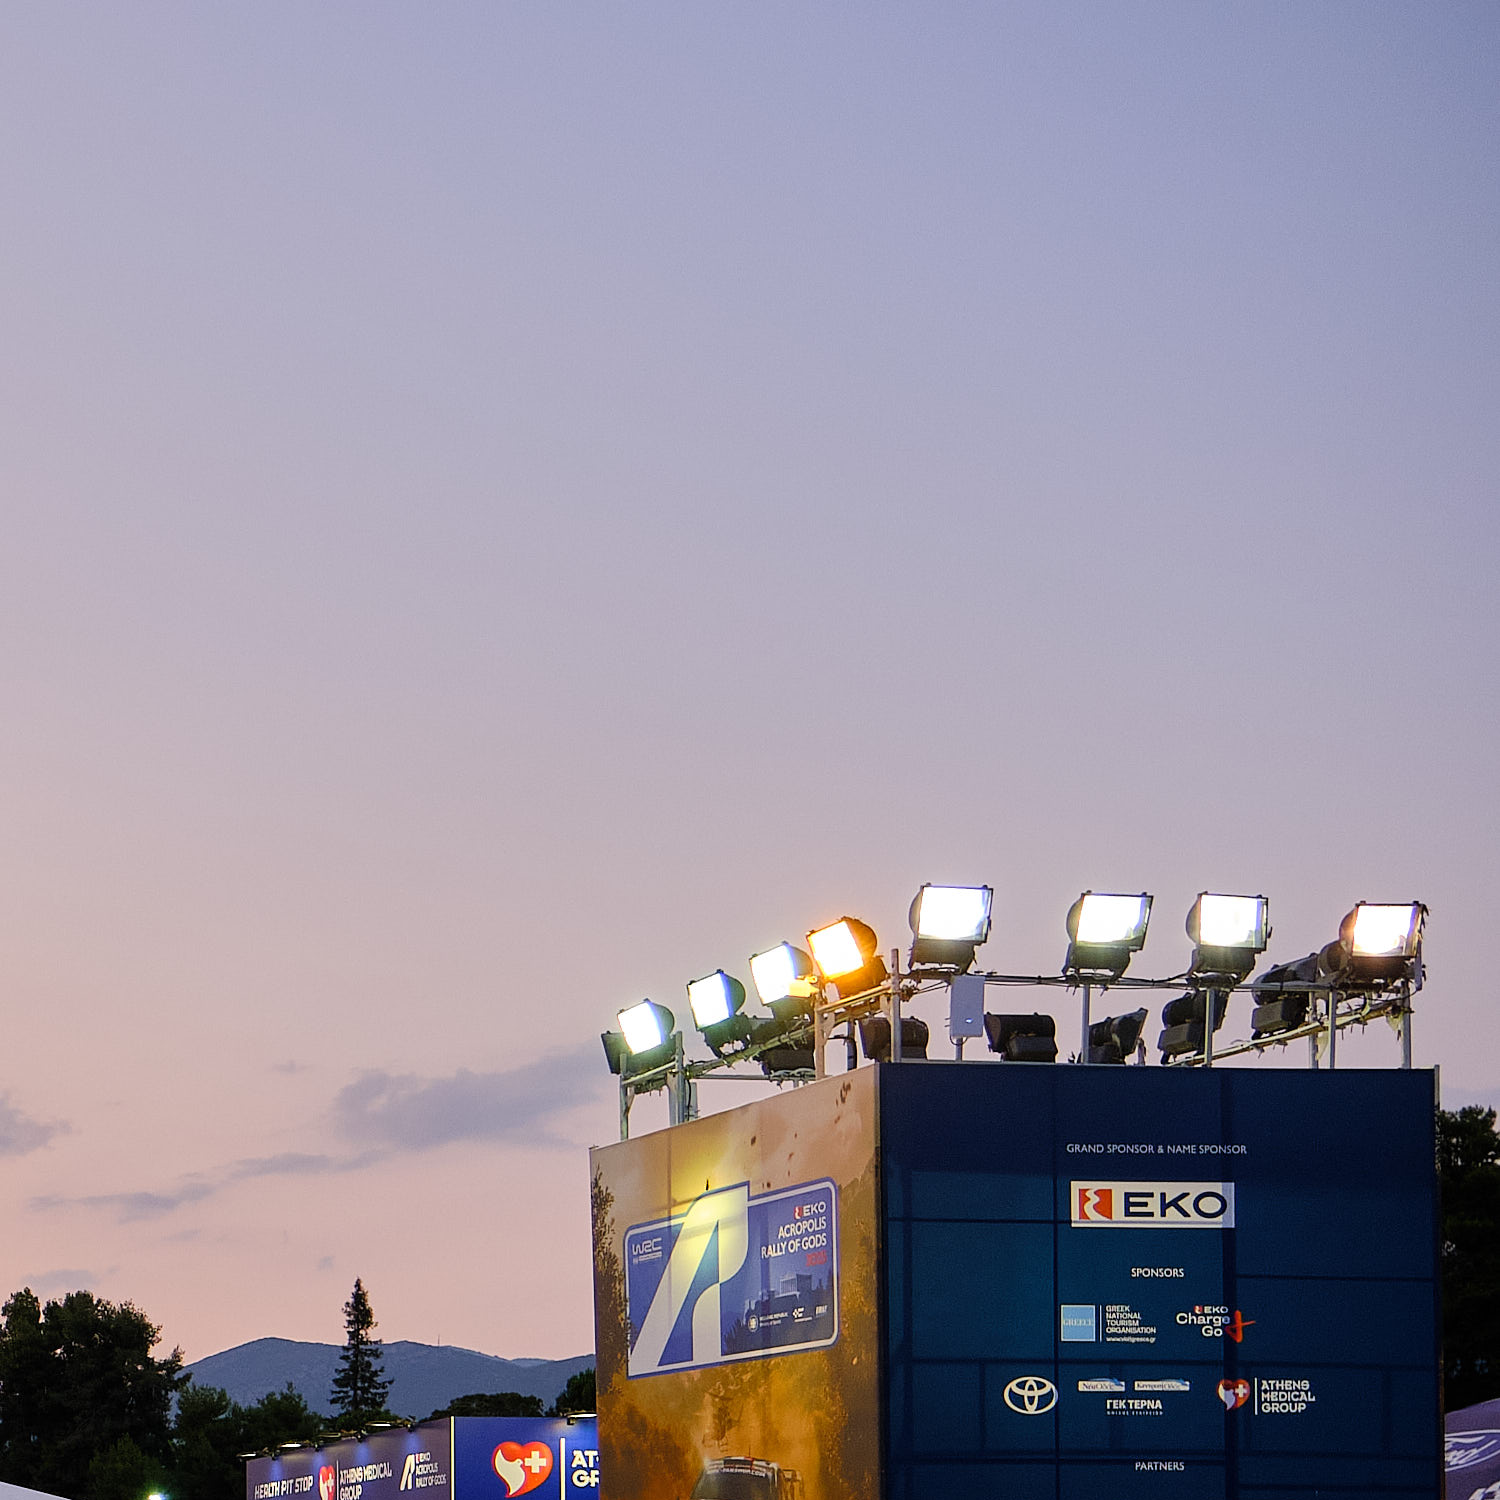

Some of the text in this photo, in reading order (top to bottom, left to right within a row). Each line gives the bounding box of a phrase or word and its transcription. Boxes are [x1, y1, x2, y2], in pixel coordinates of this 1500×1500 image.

[1066, 1143, 1247, 1155] GRAND SPONSOR & NAME SPONSOR
[803, 1201, 826, 1218] EKO
[1123, 1191, 1228, 1219] EKO
[778, 1216, 827, 1240] ACROPOLIS
[761, 1231, 827, 1260] RALLY OF GODS
[1131, 1267, 1185, 1278] SPONSORS
[1105, 1305, 1131, 1313] GREEK
[1203, 1305, 1229, 1314] EKO
[1105, 1312, 1142, 1320] NATIONAL
[1175, 1312, 1231, 1326] Charge
[1105, 1319, 1140, 1327] TOURISM
[1201, 1326, 1223, 1338] Go
[1261, 1379, 1309, 1390] ATHENS
[1261, 1391, 1316, 1402] MEDICAL
[1261, 1402, 1307, 1413] GROUP
[1134, 1461, 1185, 1471] PARTNERS
[339, 1461, 392, 1483] ATHENS MEDICAL
[254, 1475, 314, 1500] HEALTH PIT STOP
